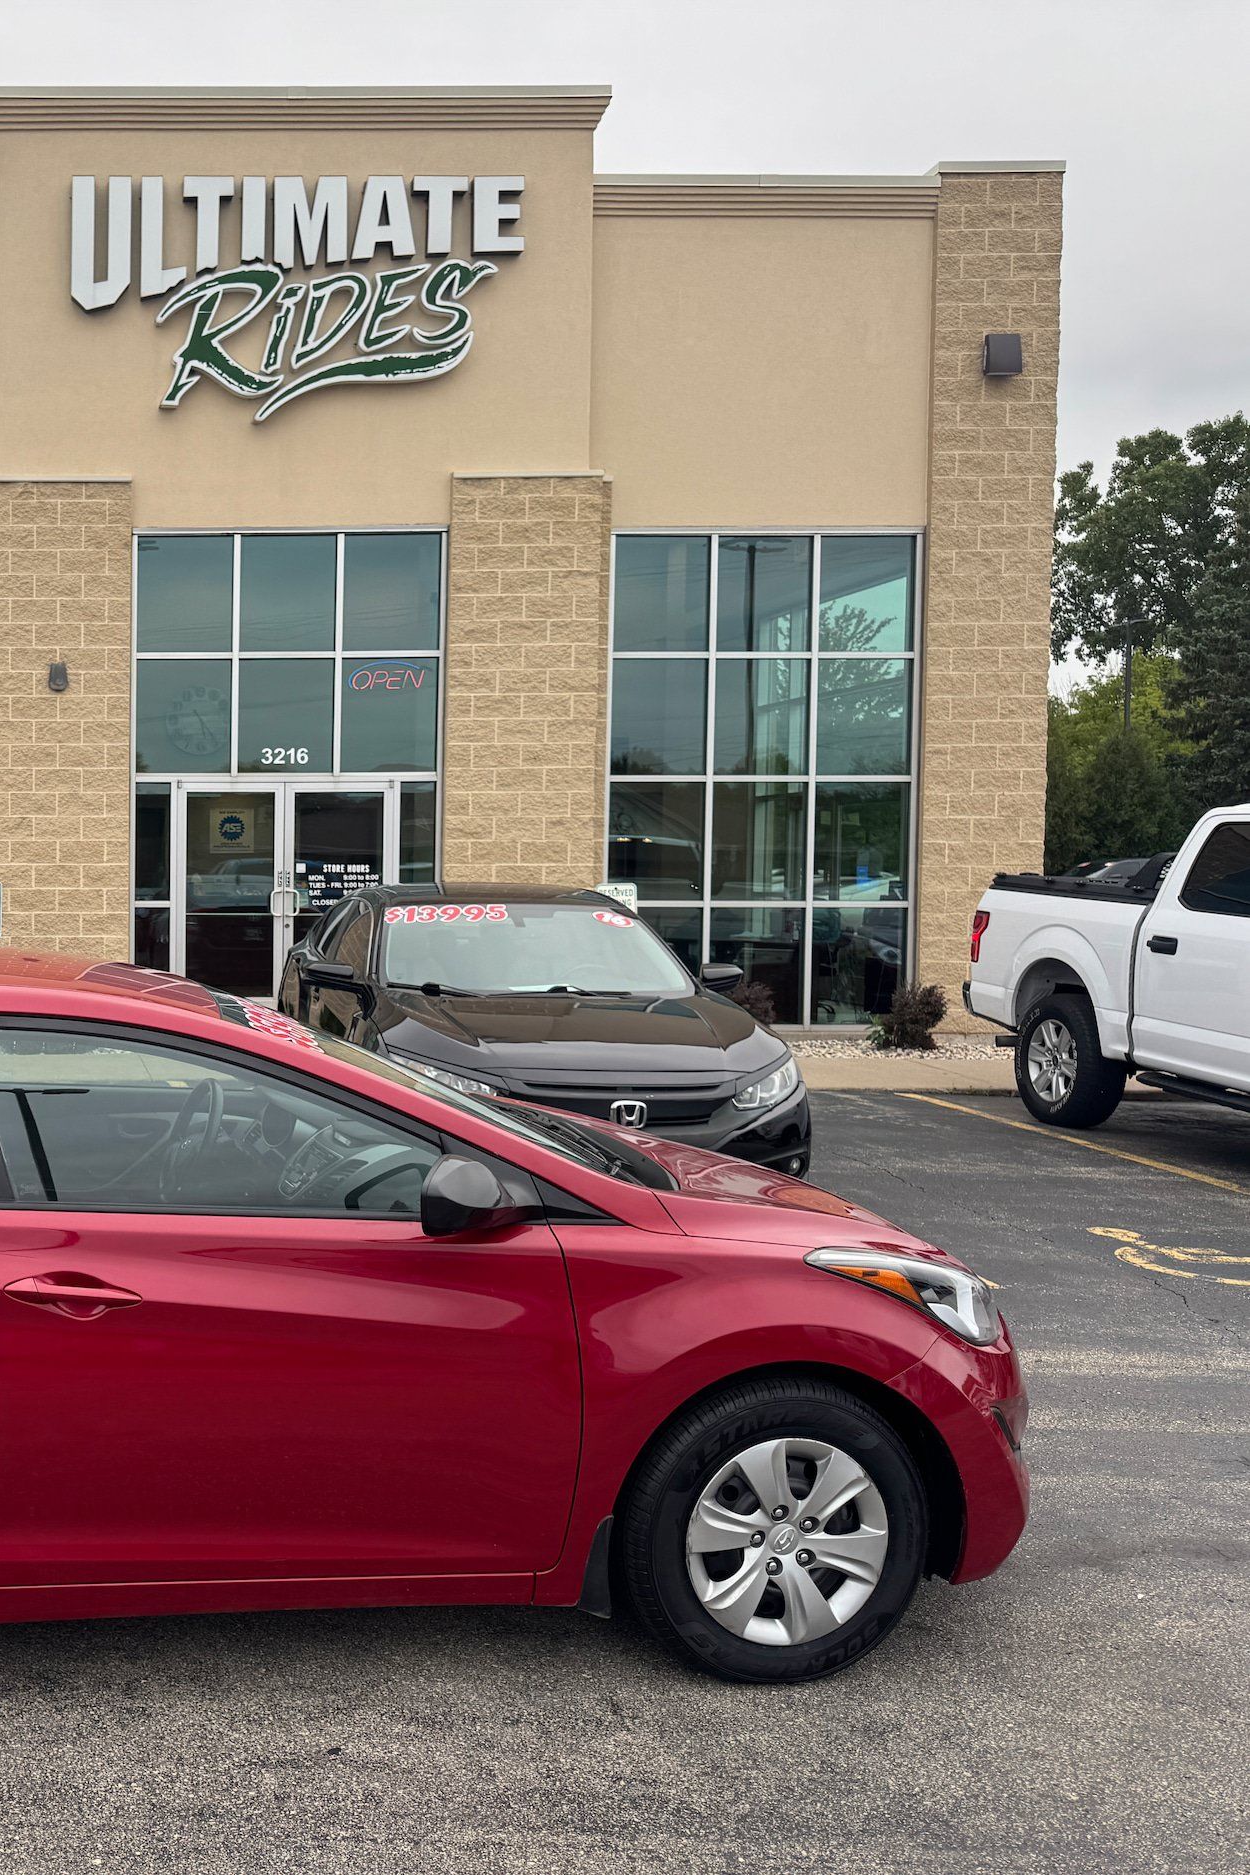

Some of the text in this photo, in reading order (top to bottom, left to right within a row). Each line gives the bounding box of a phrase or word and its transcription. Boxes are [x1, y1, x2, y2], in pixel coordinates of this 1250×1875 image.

[70, 174, 525, 313] ULTIMATE
[352, 670, 425, 690] OPEN
[260, 747, 309, 765] 3216
[221, 823, 242, 833] ASE
[322, 864, 370, 873] STORE HOURS
[384, 905, 509, 923] $13995
